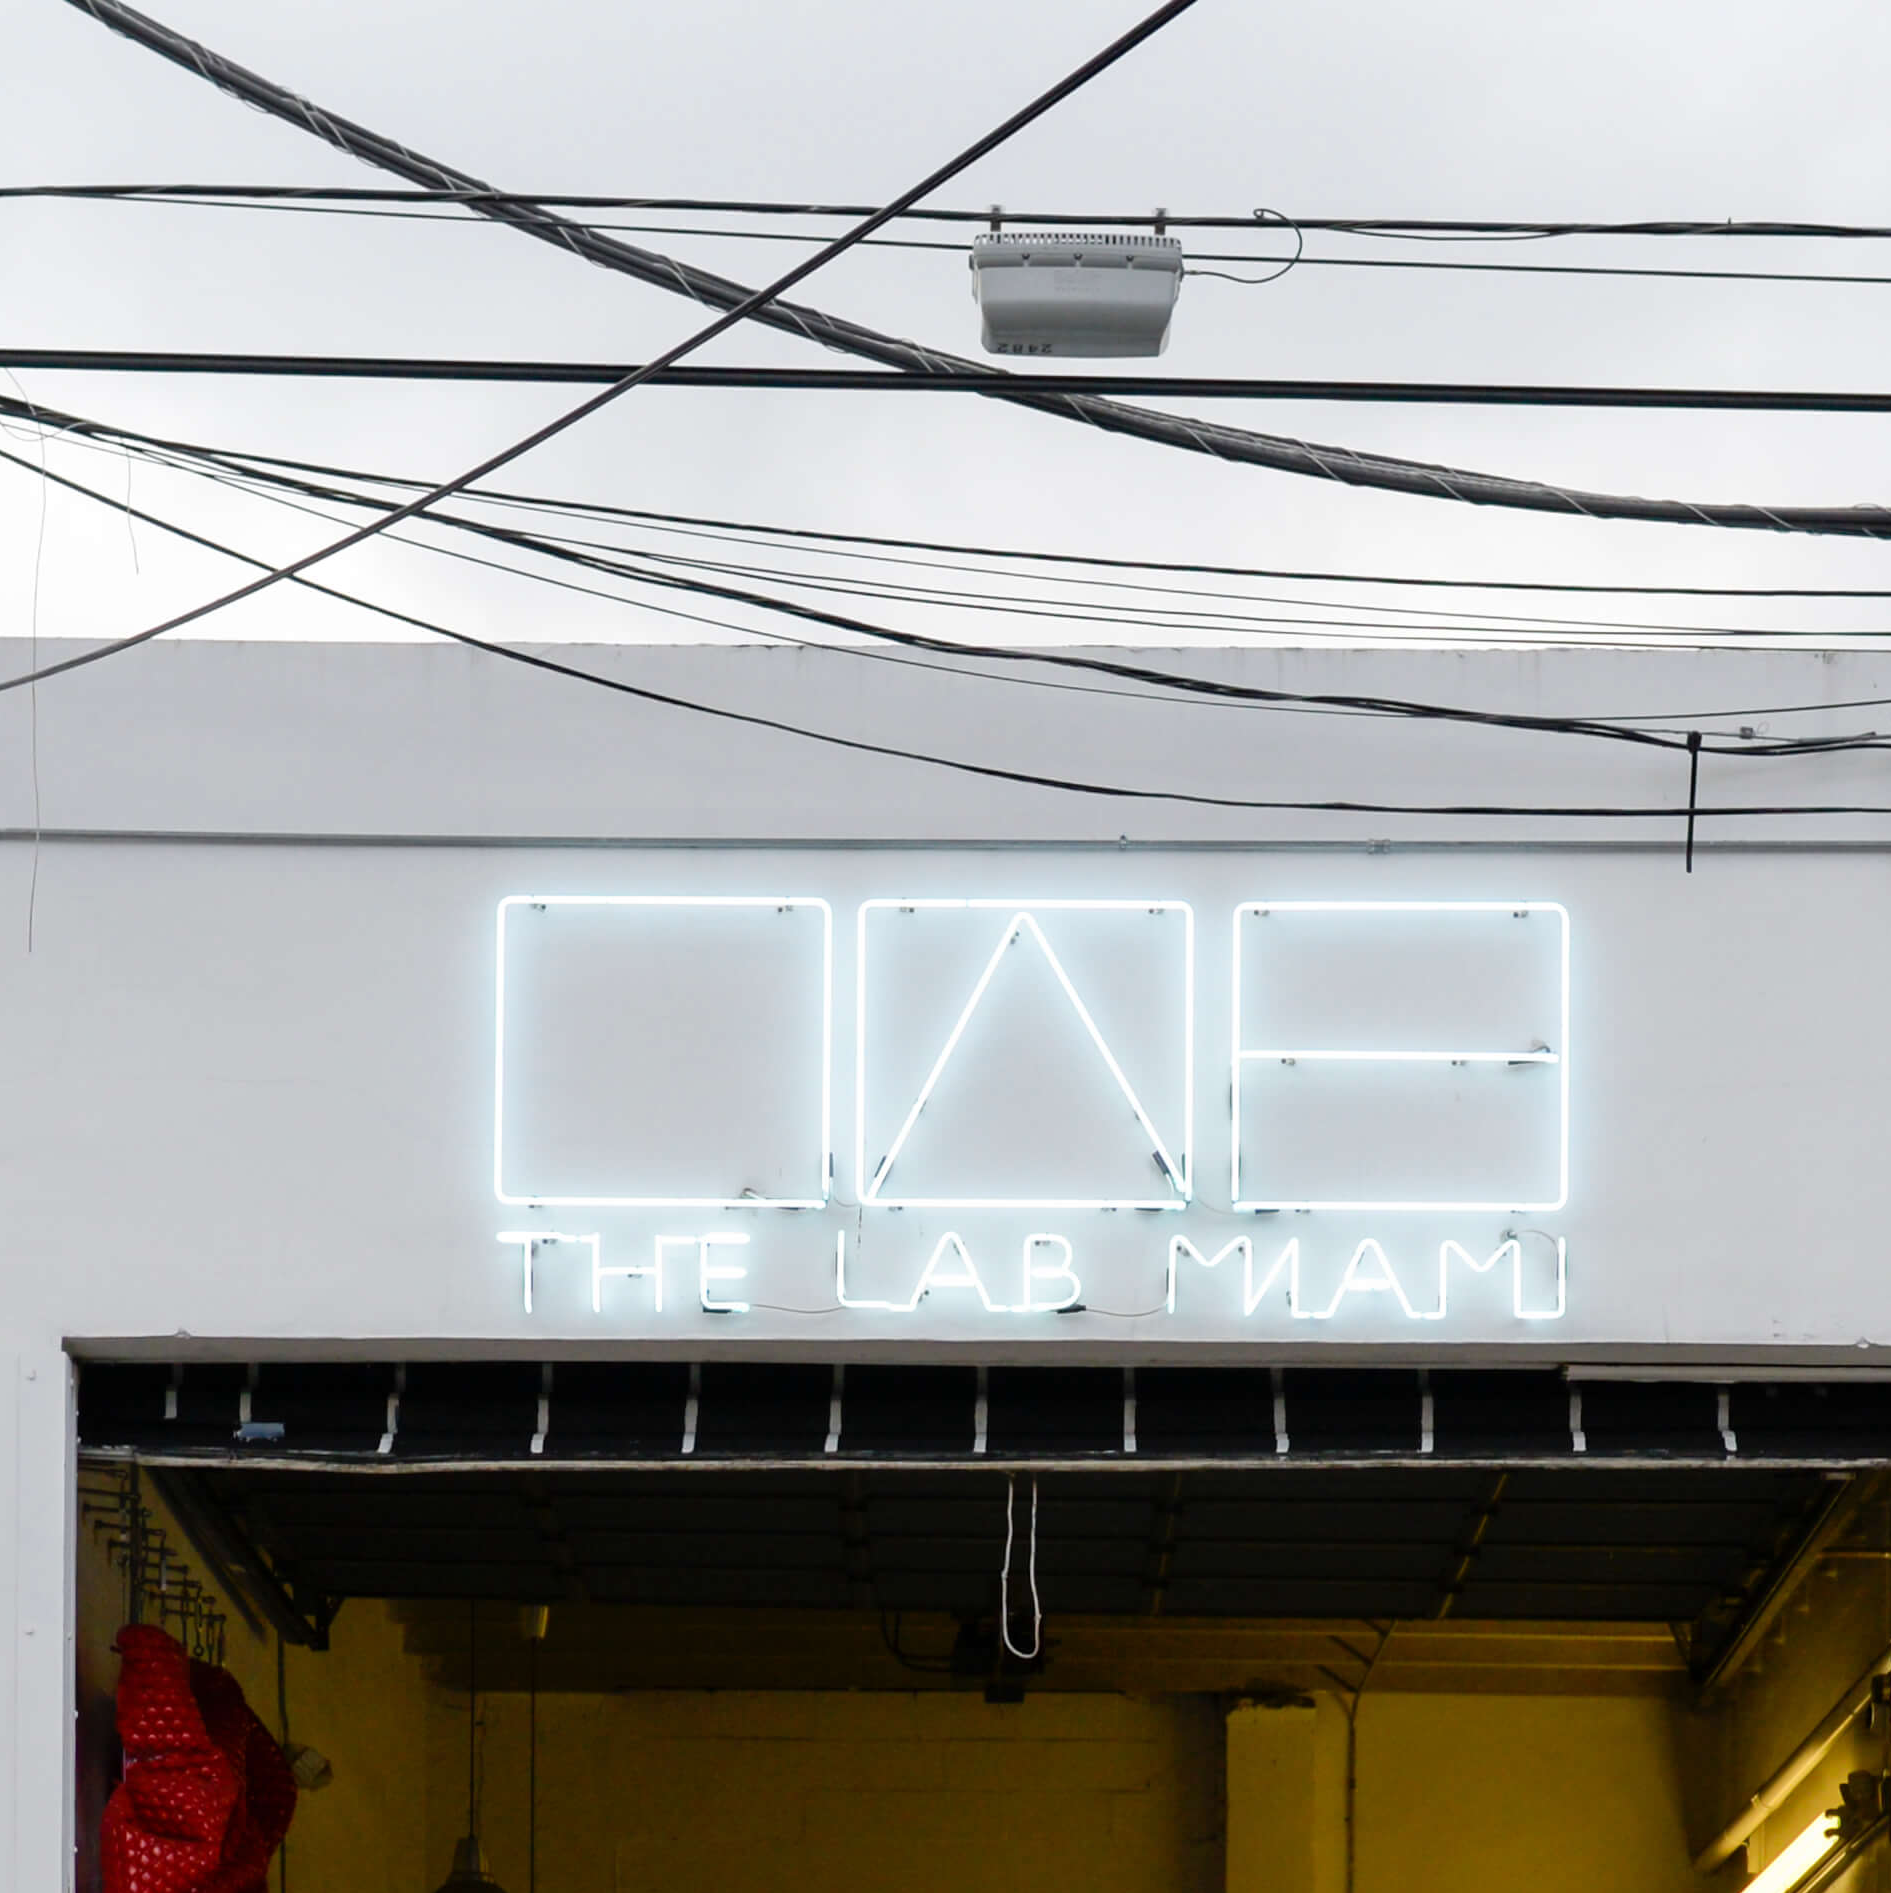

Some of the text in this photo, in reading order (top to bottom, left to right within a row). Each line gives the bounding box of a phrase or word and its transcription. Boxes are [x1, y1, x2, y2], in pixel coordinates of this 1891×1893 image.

[496, 1230, 1567, 1320] THE LAB MIAMI
